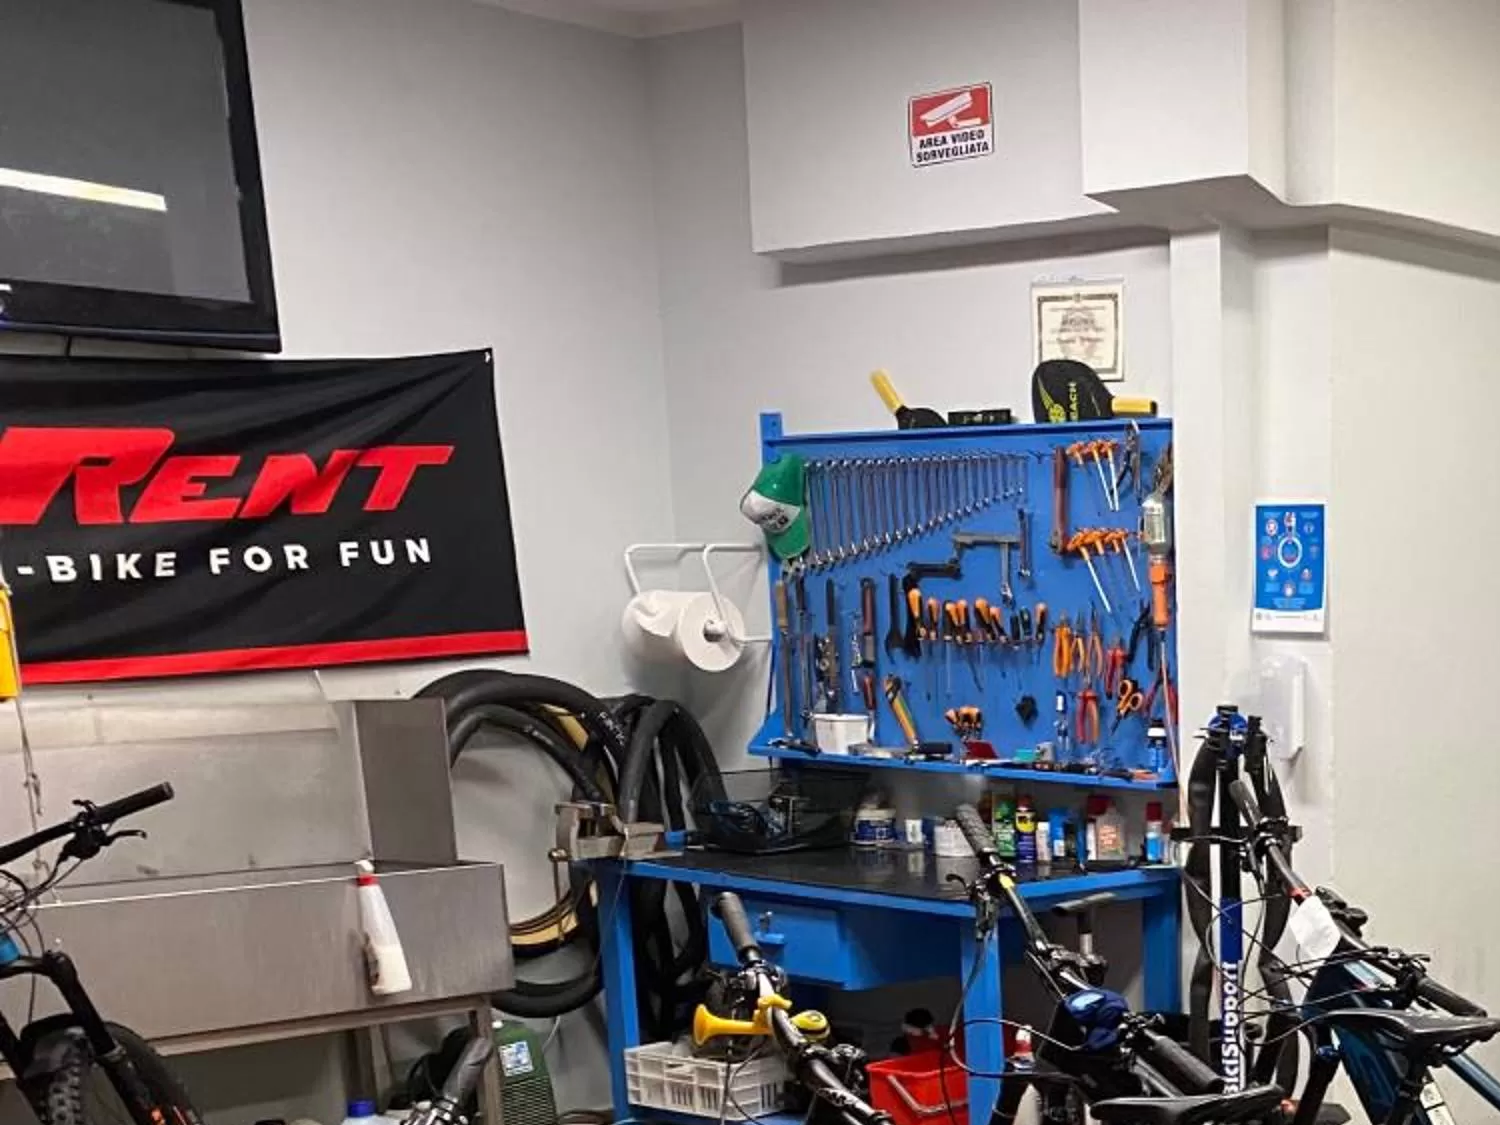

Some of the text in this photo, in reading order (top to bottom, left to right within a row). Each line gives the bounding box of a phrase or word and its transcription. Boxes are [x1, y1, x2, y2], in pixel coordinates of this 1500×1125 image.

[919, 129, 985, 149] AREA VIDEO
[916, 141, 989, 163] SORVEGLIATA
[209, 543, 310, 575] FOR
[339, 537, 432, 567] FUN
